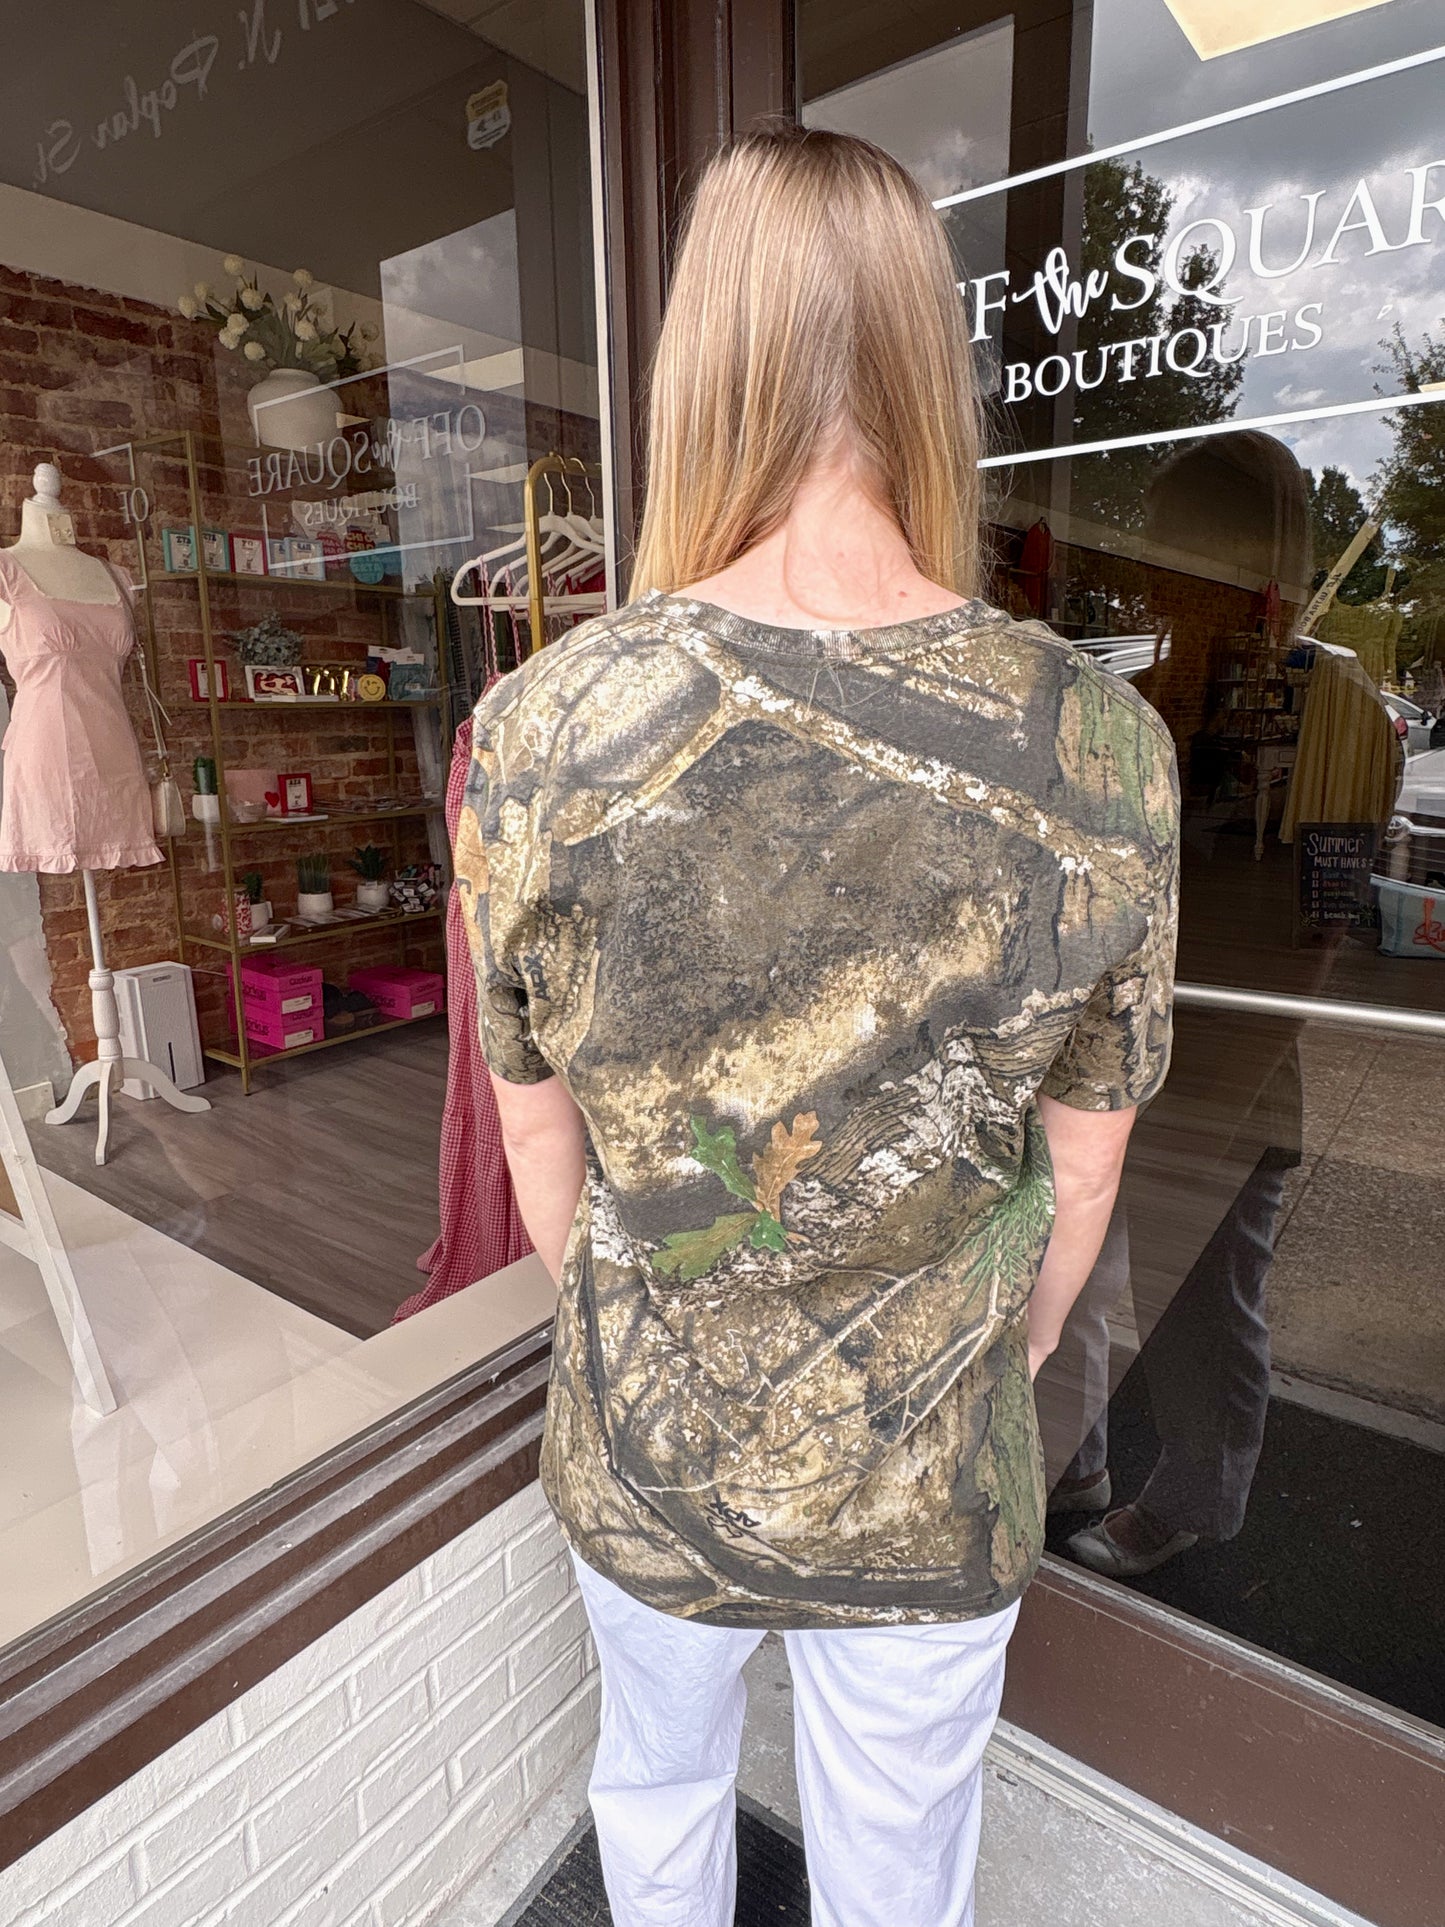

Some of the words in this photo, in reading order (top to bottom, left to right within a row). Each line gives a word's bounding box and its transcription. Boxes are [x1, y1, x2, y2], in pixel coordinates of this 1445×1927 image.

[1012, 246, 1109, 335] the
[1004, 302, 1324, 404] BOUTIQUES
[1306, 832, 1365, 856] Summer
[1314, 856, 1339, 868] MUST
